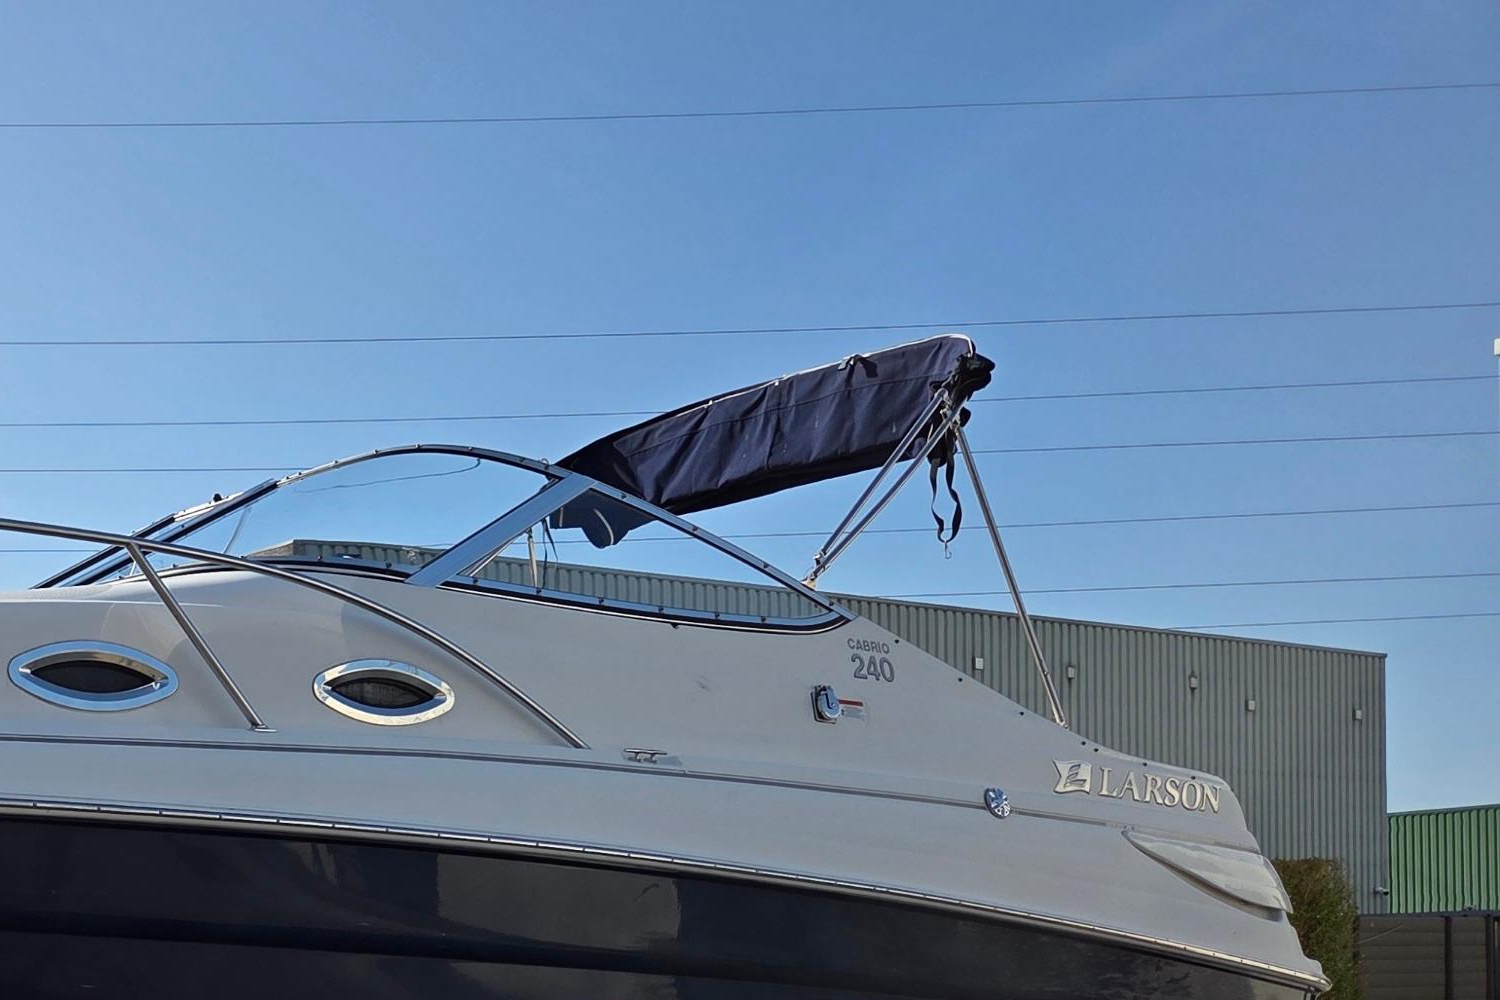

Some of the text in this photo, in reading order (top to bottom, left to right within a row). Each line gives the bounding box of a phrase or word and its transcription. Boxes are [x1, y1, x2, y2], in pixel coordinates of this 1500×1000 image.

[847, 638, 890, 654] CABRIO
[851, 653, 895, 683] 240
[1100, 767, 1222, 813] LARSON
